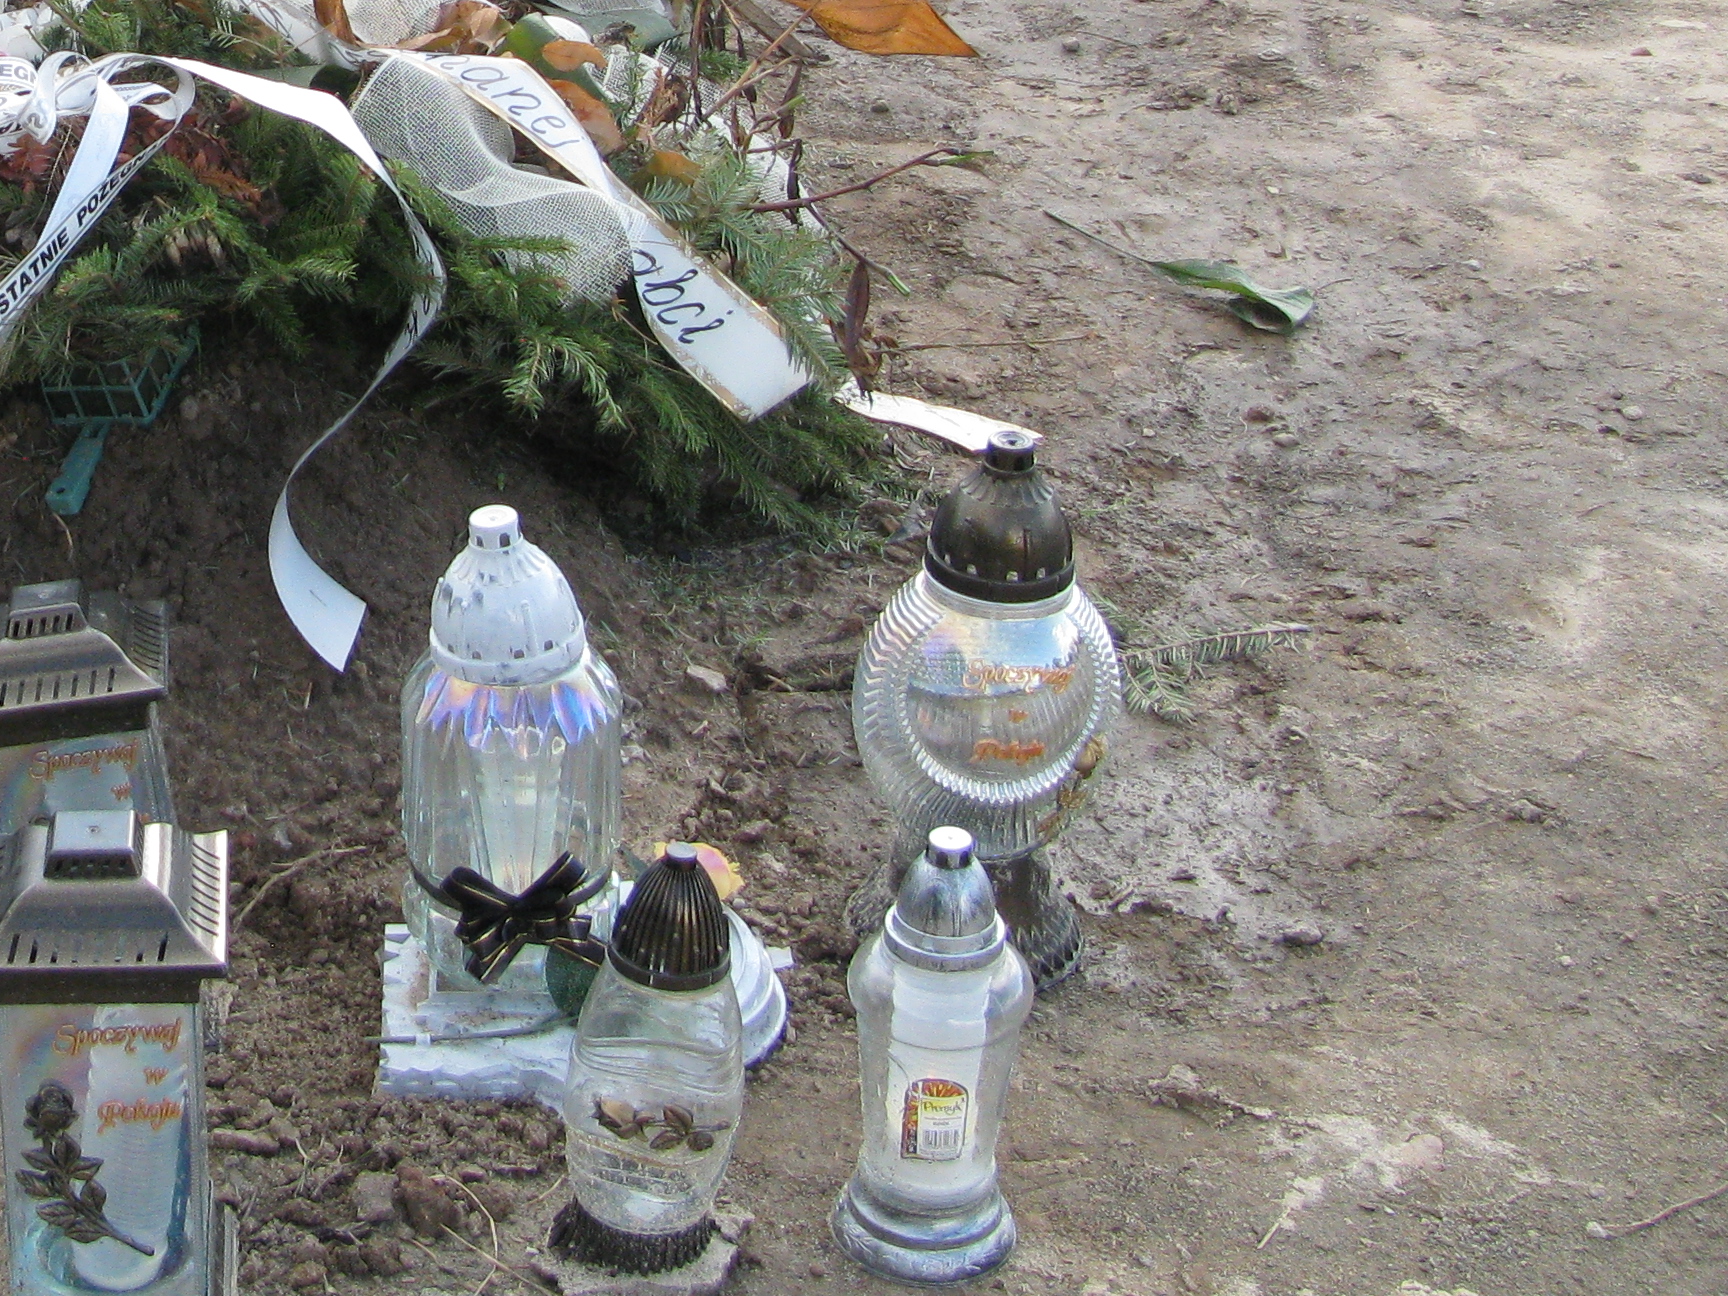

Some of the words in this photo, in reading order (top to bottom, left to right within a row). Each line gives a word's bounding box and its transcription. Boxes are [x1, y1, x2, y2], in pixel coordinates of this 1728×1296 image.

[629, 248, 726, 345] abci
[29, 738, 140, 781] Spoczywaj
[52, 1017, 183, 1055] Spoczywaj
[143, 1067, 169, 1086] w
[97, 1097, 184, 1135] Pokoju
